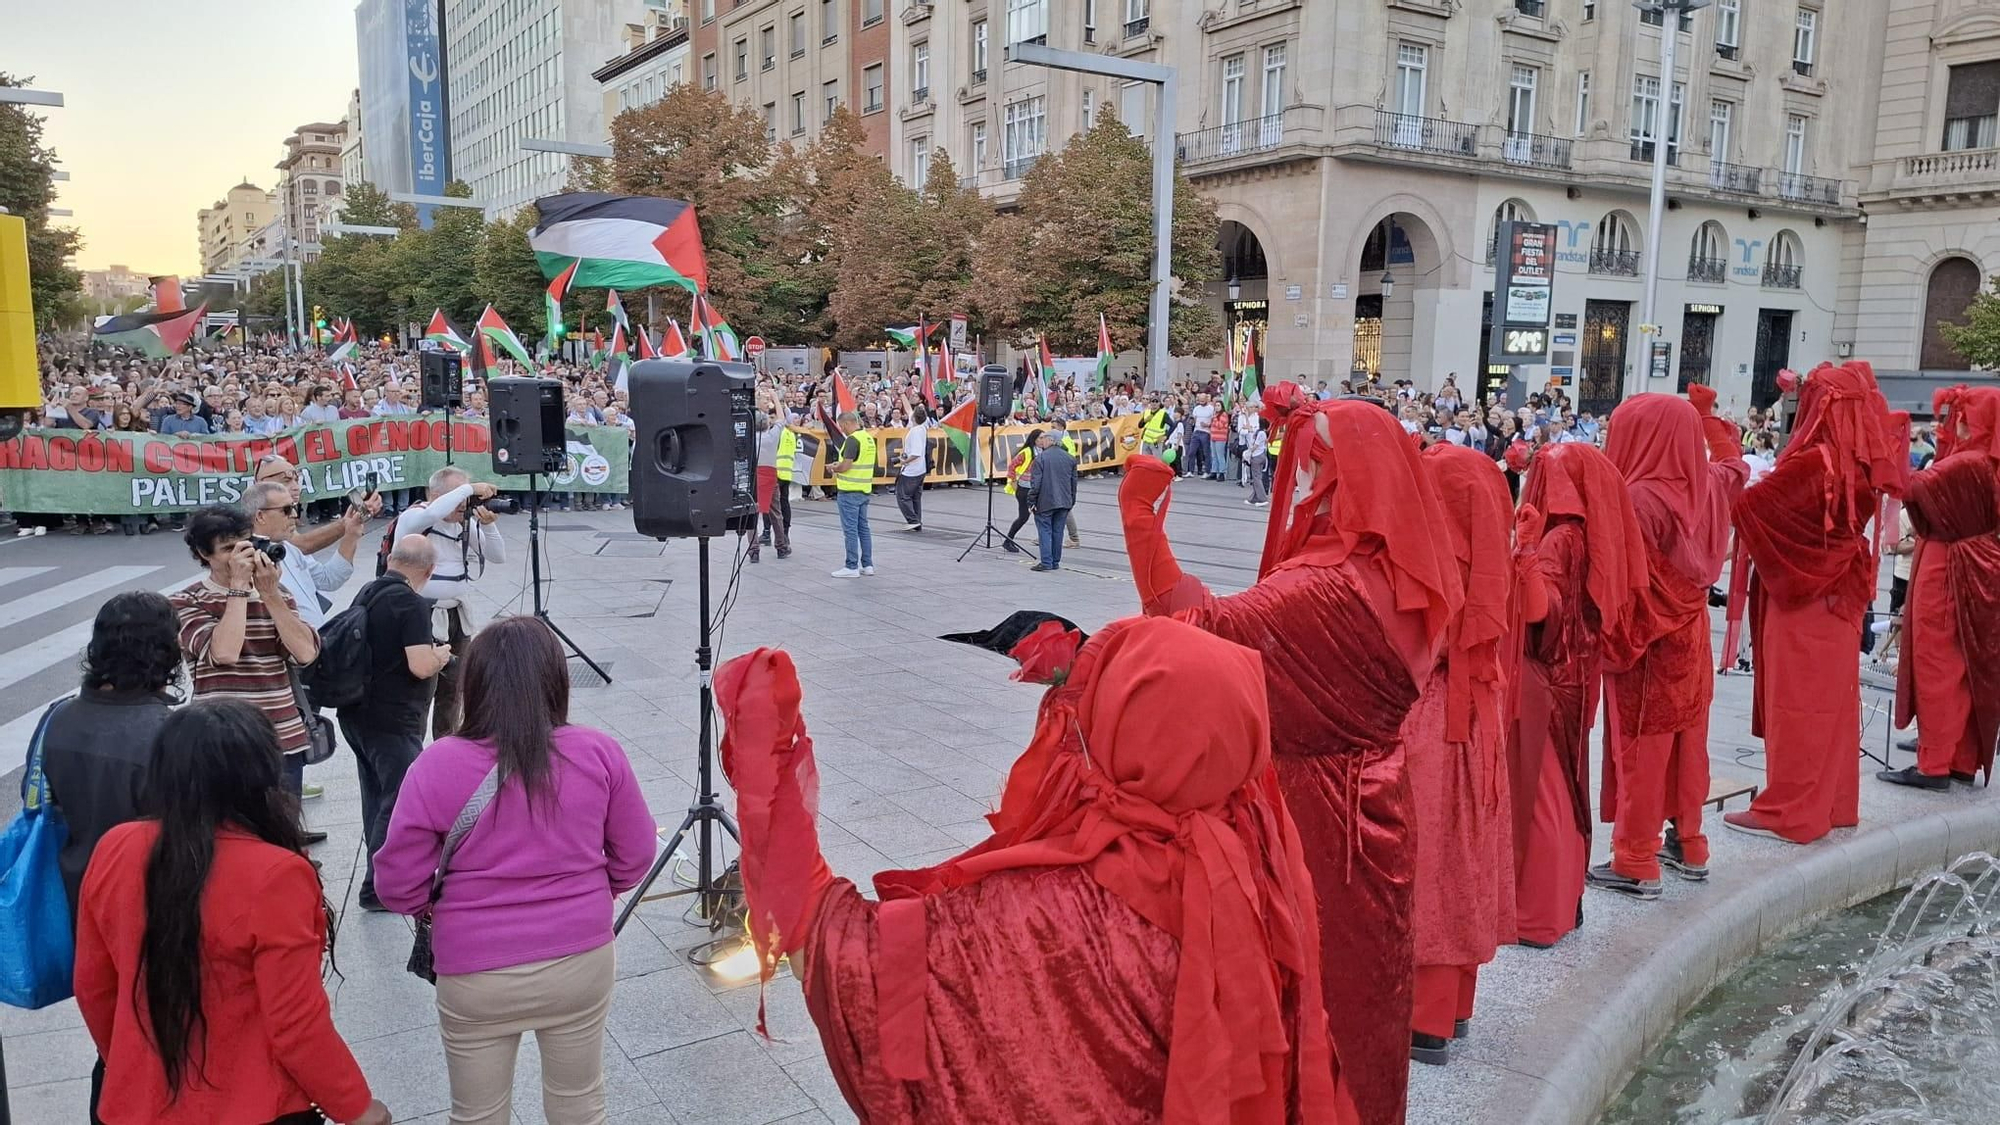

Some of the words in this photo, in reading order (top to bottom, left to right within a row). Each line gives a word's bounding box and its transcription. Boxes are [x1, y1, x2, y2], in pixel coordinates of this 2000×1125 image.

[1523, 239, 1543, 248] GRAN
[1521, 247, 1545, 257] FIESTA
[1525, 257, 1538, 266] DEL
[1518, 266, 1545, 275] OUTLET
[1233, 301, 1266, 310] SEPHORA
[1690, 304, 1720, 313] SEPHORA
[144, 434, 299, 474] CONTRA
[304, 428, 341, 463] EL
[347, 420, 492, 456] GENOCID
[131, 467, 316, 507] PALESA
[325, 455, 405, 492] LIBRE
